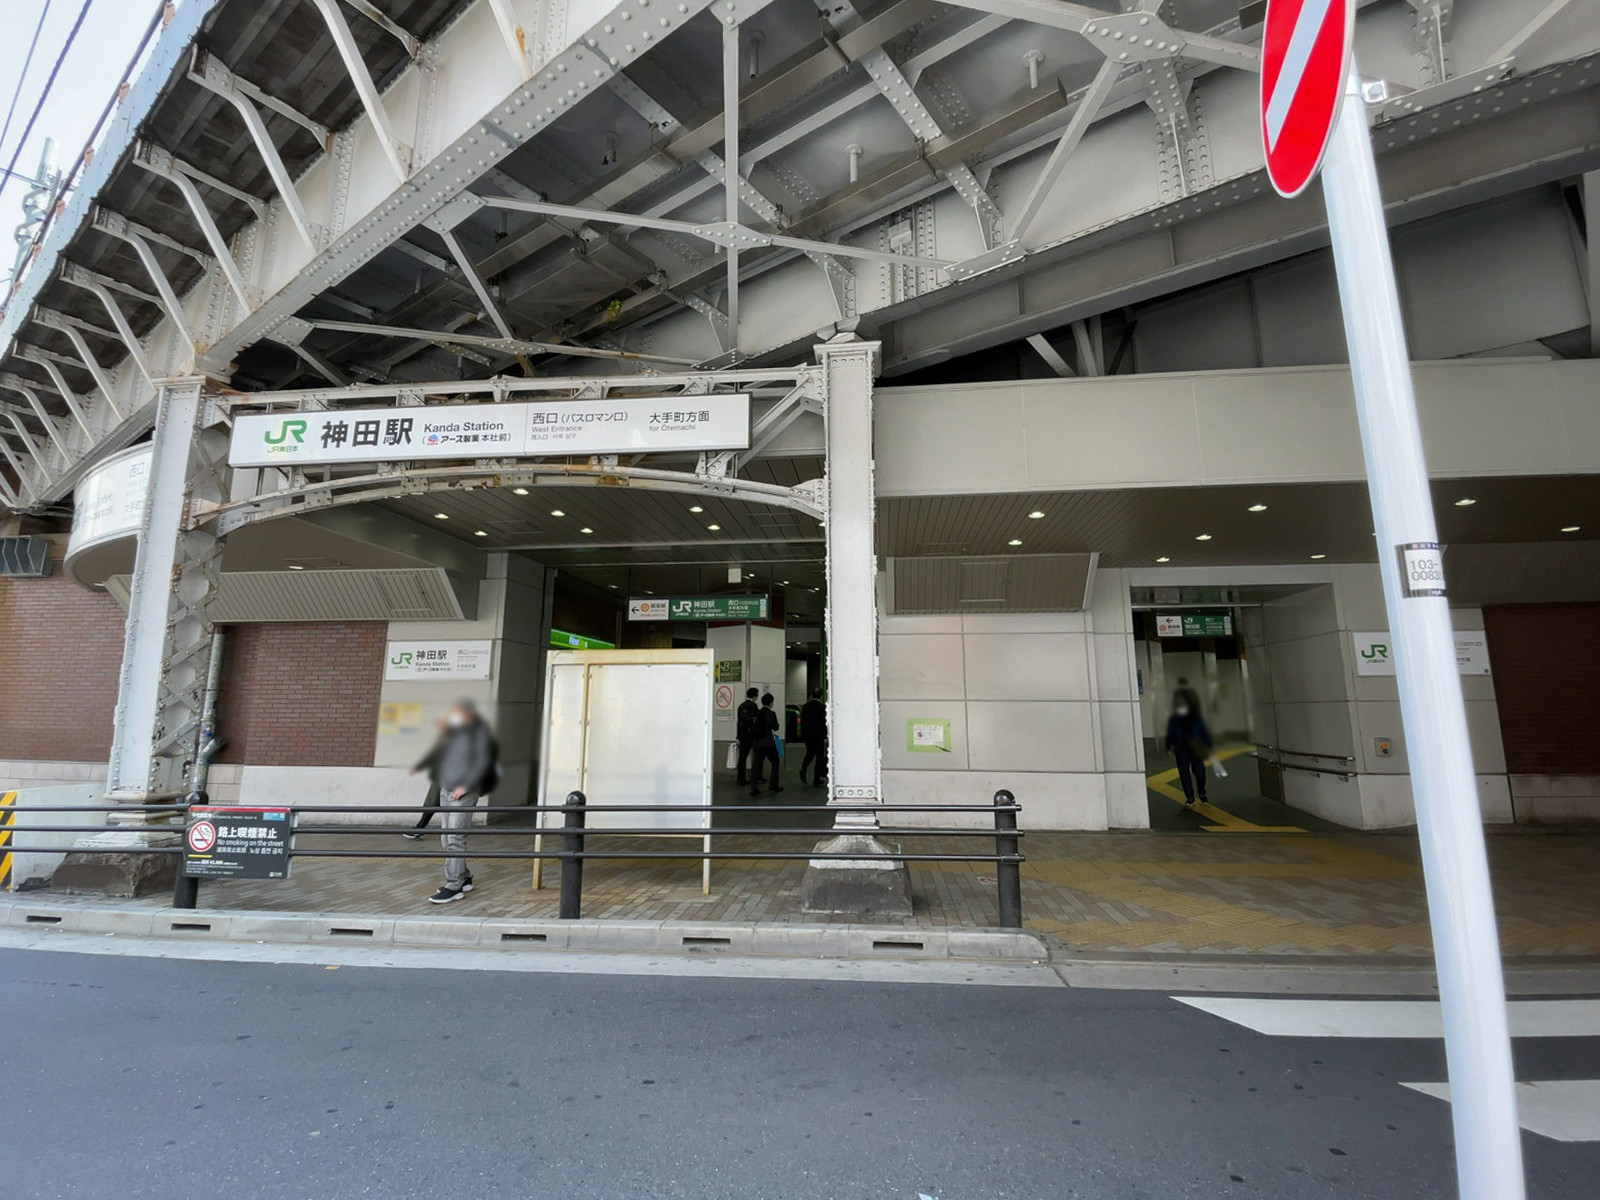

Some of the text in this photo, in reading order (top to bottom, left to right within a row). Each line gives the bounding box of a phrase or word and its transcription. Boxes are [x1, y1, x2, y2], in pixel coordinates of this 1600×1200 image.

[649, 411, 710, 423] 大手町方面
[264, 420, 307, 444] JR
[423, 421, 504, 433] Kanda Station
[320, 418, 413, 449] 神田駅
[1410, 559, 1439, 570] 103-
[672, 601, 692, 612] JR
[416, 650, 447, 660] 神田駅
[1361, 644, 1388, 658] JR
[391, 652, 413, 665] JR
[217, 826, 278, 839] 路上喫煙禁止
[225, 839, 249, 847] smoking
